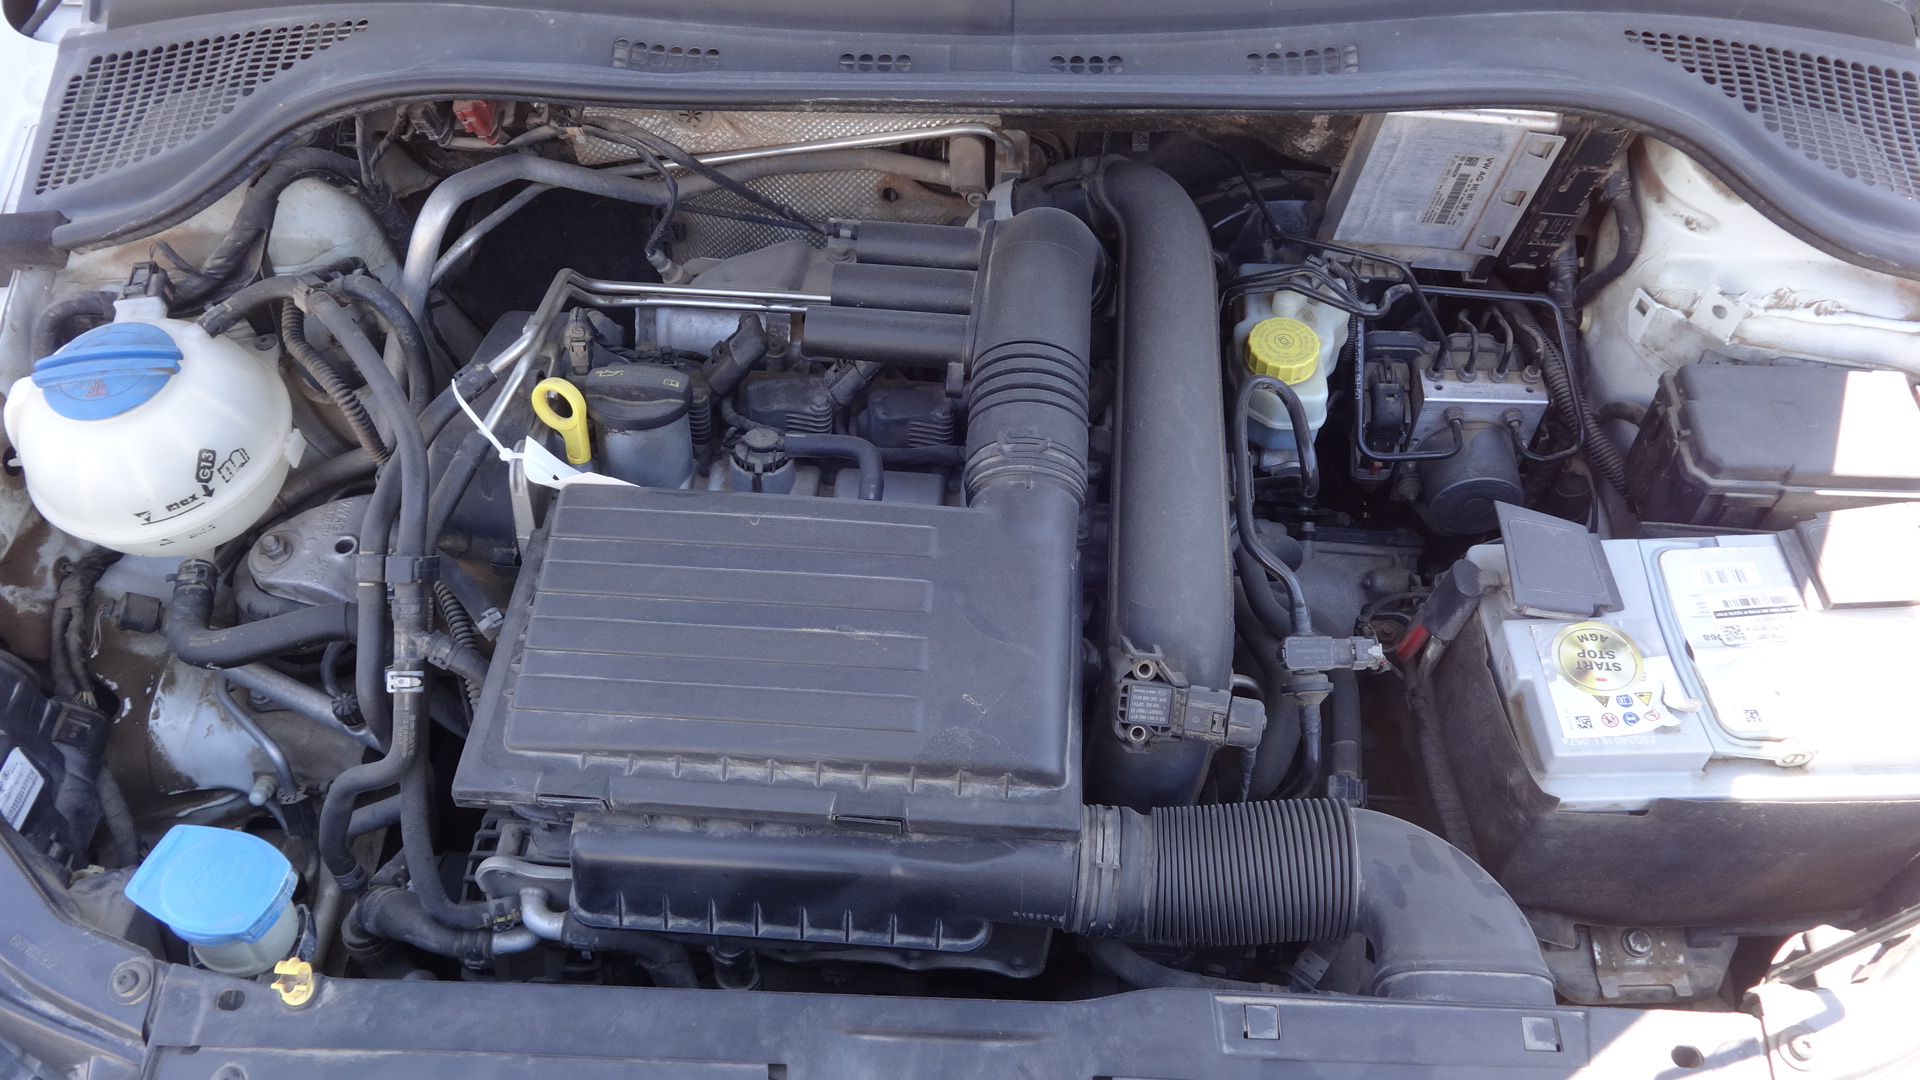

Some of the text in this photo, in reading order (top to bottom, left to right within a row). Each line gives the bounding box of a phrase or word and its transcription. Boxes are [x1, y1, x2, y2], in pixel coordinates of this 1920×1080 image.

[1452, 162, 1462, 178] BOSCH
[1482, 158, 1494, 170] VW
[1476, 171, 1486, 181] AG
[198, 451, 214, 480] G13
[165, 493, 200, 512] max
[1576, 633, 1609, 643] AGM
[1576, 648, 1616, 660] STOP
[1575, 660, 1622, 672] START
